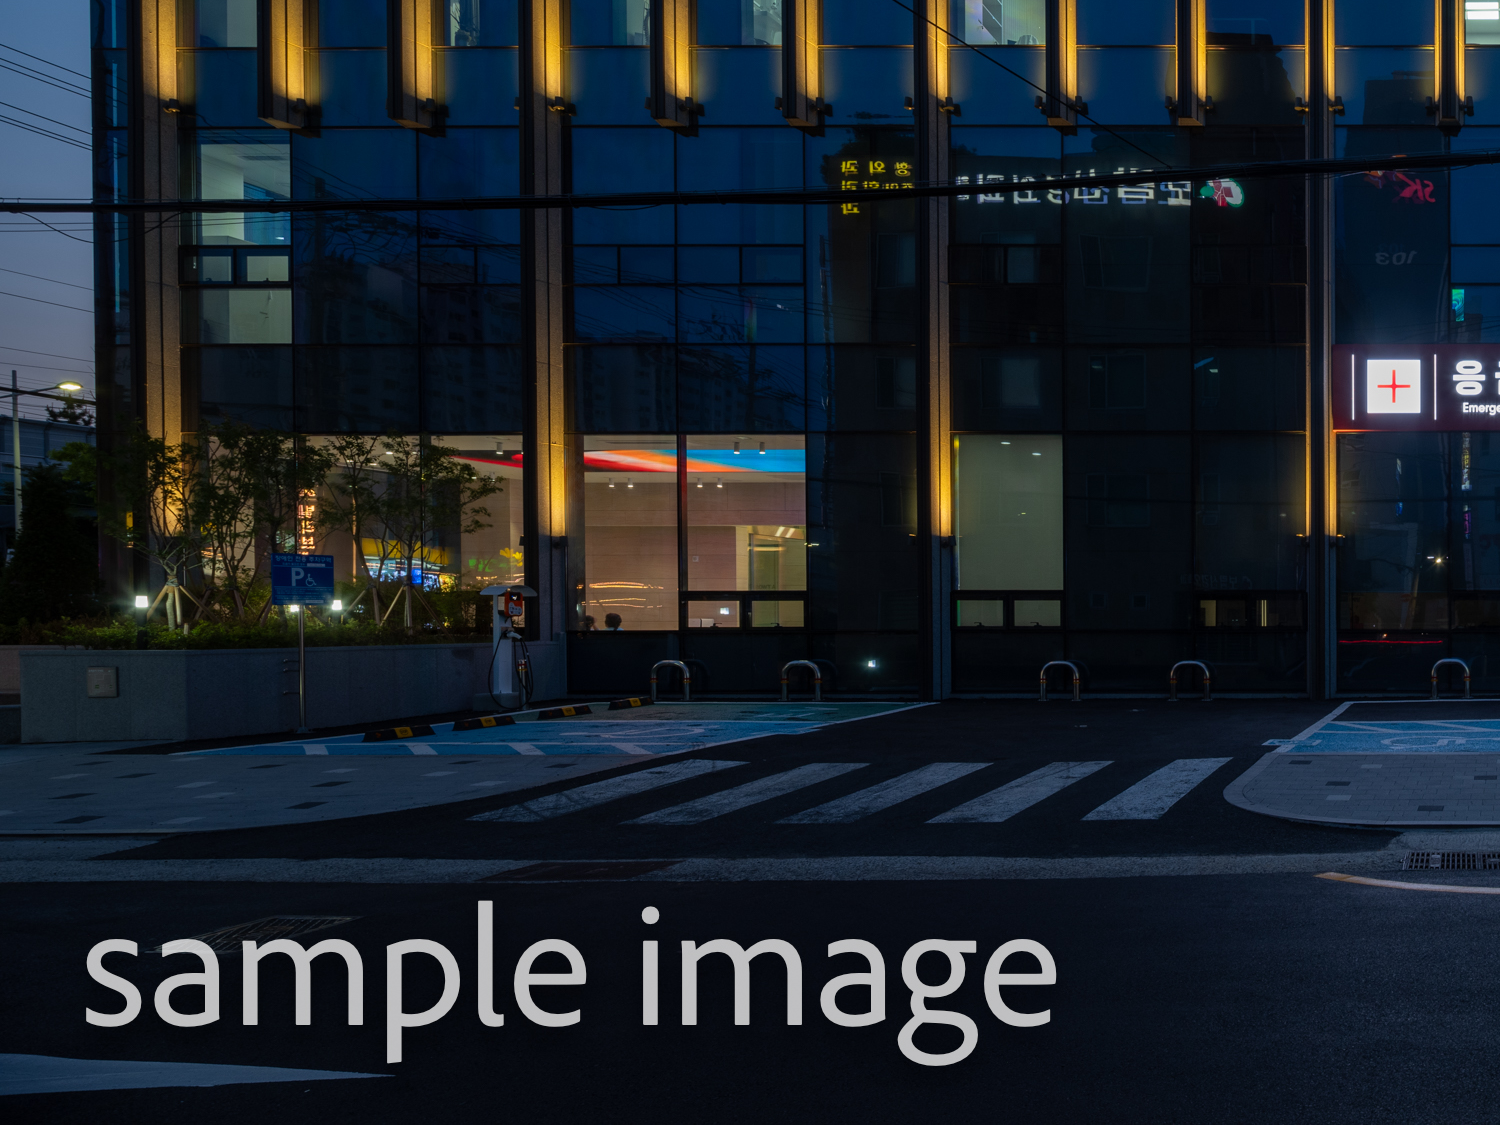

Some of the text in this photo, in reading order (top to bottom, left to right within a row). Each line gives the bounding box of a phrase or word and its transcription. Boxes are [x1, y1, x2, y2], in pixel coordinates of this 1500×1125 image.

[295, 555, 307, 563] 전용
[308, 556, 332, 564] 주차구역
[291, 567, 305, 587] P
